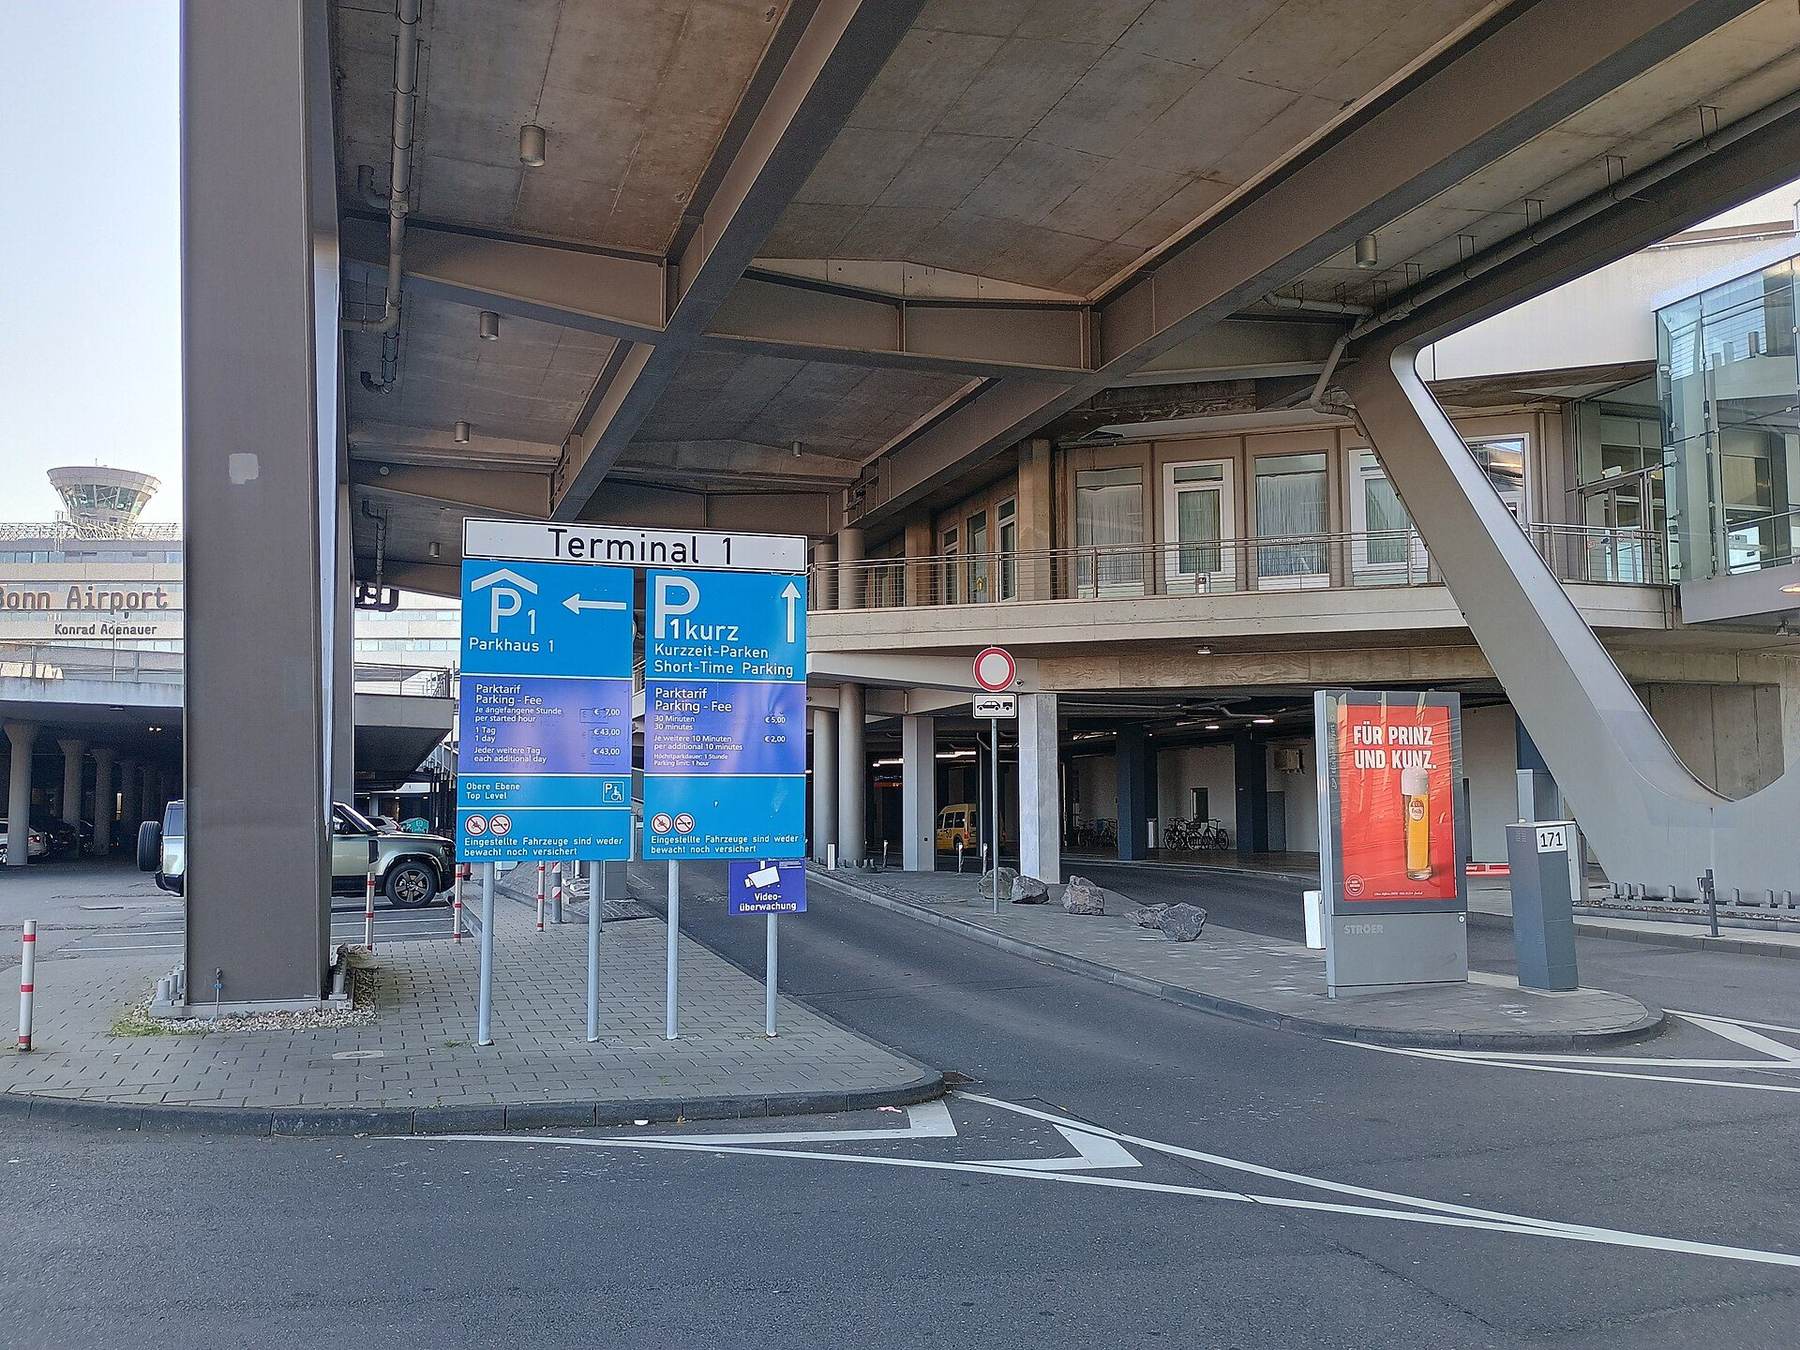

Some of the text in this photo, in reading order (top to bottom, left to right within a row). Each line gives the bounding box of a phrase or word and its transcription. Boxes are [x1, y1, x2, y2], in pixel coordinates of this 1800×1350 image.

[548, 528, 732, 565] Terminal 1
[66, 585, 168, 615] Airport
[54, 623, 96, 635] Konrad
[469, 637, 554, 652] Parkhaus 1
[655, 643, 769, 659] Kurzzeit-Parken
[654, 660, 793, 679] Short-Time Parking
[476, 684, 521, 694] Parktarif
[655, 687, 708, 699] Parktarif
[476, 695, 515, 706] Parking
[524, 696, 543, 705] Fee
[475, 706, 562, 716] Je angefangene Stunde
[655, 700, 700, 713] Parking
[711, 701, 732, 712] Fee
[605, 709, 621, 717] 7,00
[475, 714, 536, 724] per started hour
[654, 715, 695, 723] 30 Minuten
[771, 716, 786, 725] 5,00
[482, 726, 496, 736] Tag
[654, 723, 693, 731] 30 minutes
[1353, 721, 1434, 746] FÜR PRINZ
[481, 735, 496, 744] day
[664, 735, 690, 743] weitere
[771, 736, 786, 744] 2,00
[474, 746, 541, 756] Jeder weitere Tag
[668, 743, 703, 751] additional
[474, 755, 547, 764] each additional day
[1354, 749, 1437, 770] UND KUNZ.
[466, 782, 521, 791] Obere Ebene
[466, 792, 507, 800] Top Level
[464, 837, 624, 847] Eingestellte Fahrzeuge sind weder
[651, 835, 799, 845] Eingestellte Fahrzeuge sind weder
[1540, 831, 1563, 848] 171
[464, 848, 578, 857] bewacht noch versichert
[651, 845, 757, 854] bewacht noch versichert
[754, 893, 782, 901] Video-
[739, 902, 797, 912] überwachung
